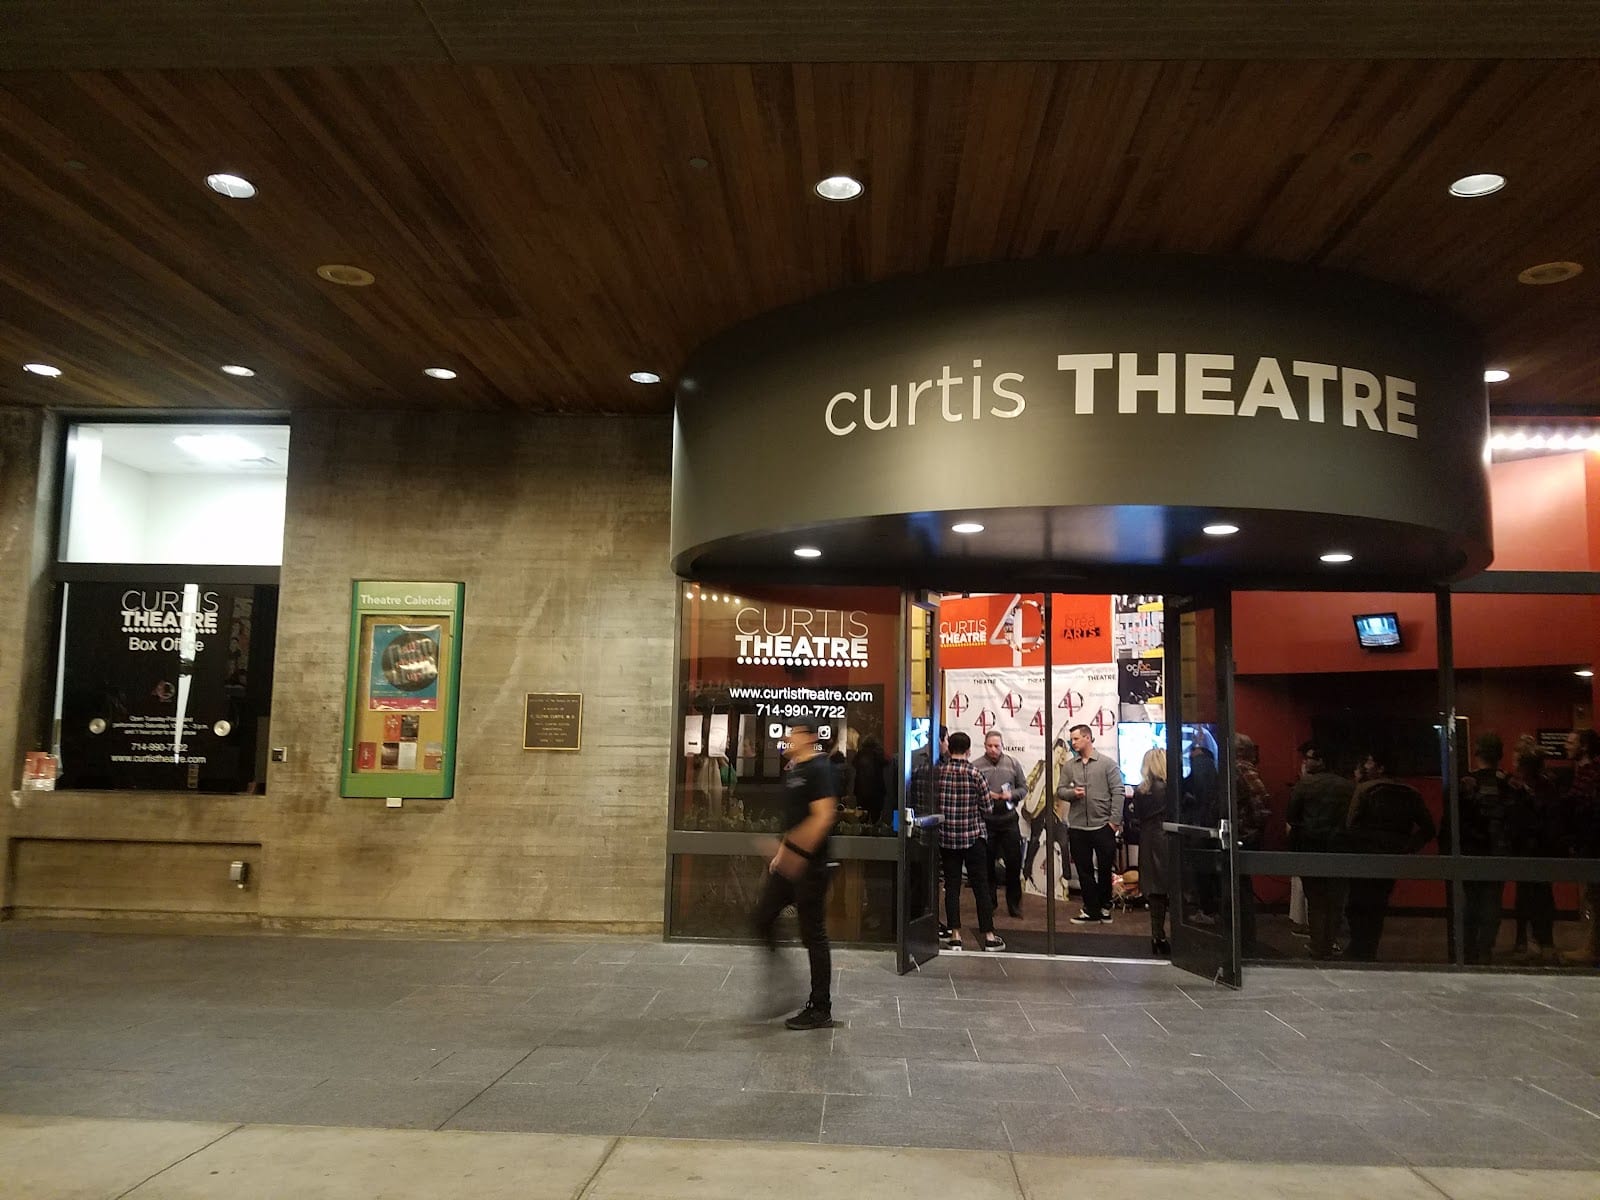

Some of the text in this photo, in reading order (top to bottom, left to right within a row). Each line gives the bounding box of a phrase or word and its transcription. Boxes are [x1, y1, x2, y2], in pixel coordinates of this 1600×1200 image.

[823, 352, 1419, 439] curtis THEATRE
[360, 594, 453, 607] Theatre Calendar
[735, 607, 869, 638] CURTIS
[939, 618, 987, 634] CURTIS
[1064, 613, 1096, 628] brea
[939, 631, 987, 645] THEATRE
[1064, 627, 1097, 640] ARTS
[128, 636, 158, 651] Box
[735, 635, 869, 660] THEATRE
[1087, 674, 1117, 682] THEATRE
[729, 686, 873, 703] www.curtistheatre.com
[756, 704, 846, 719] 714-990-7722
[1029, 707, 1045, 736] 4
